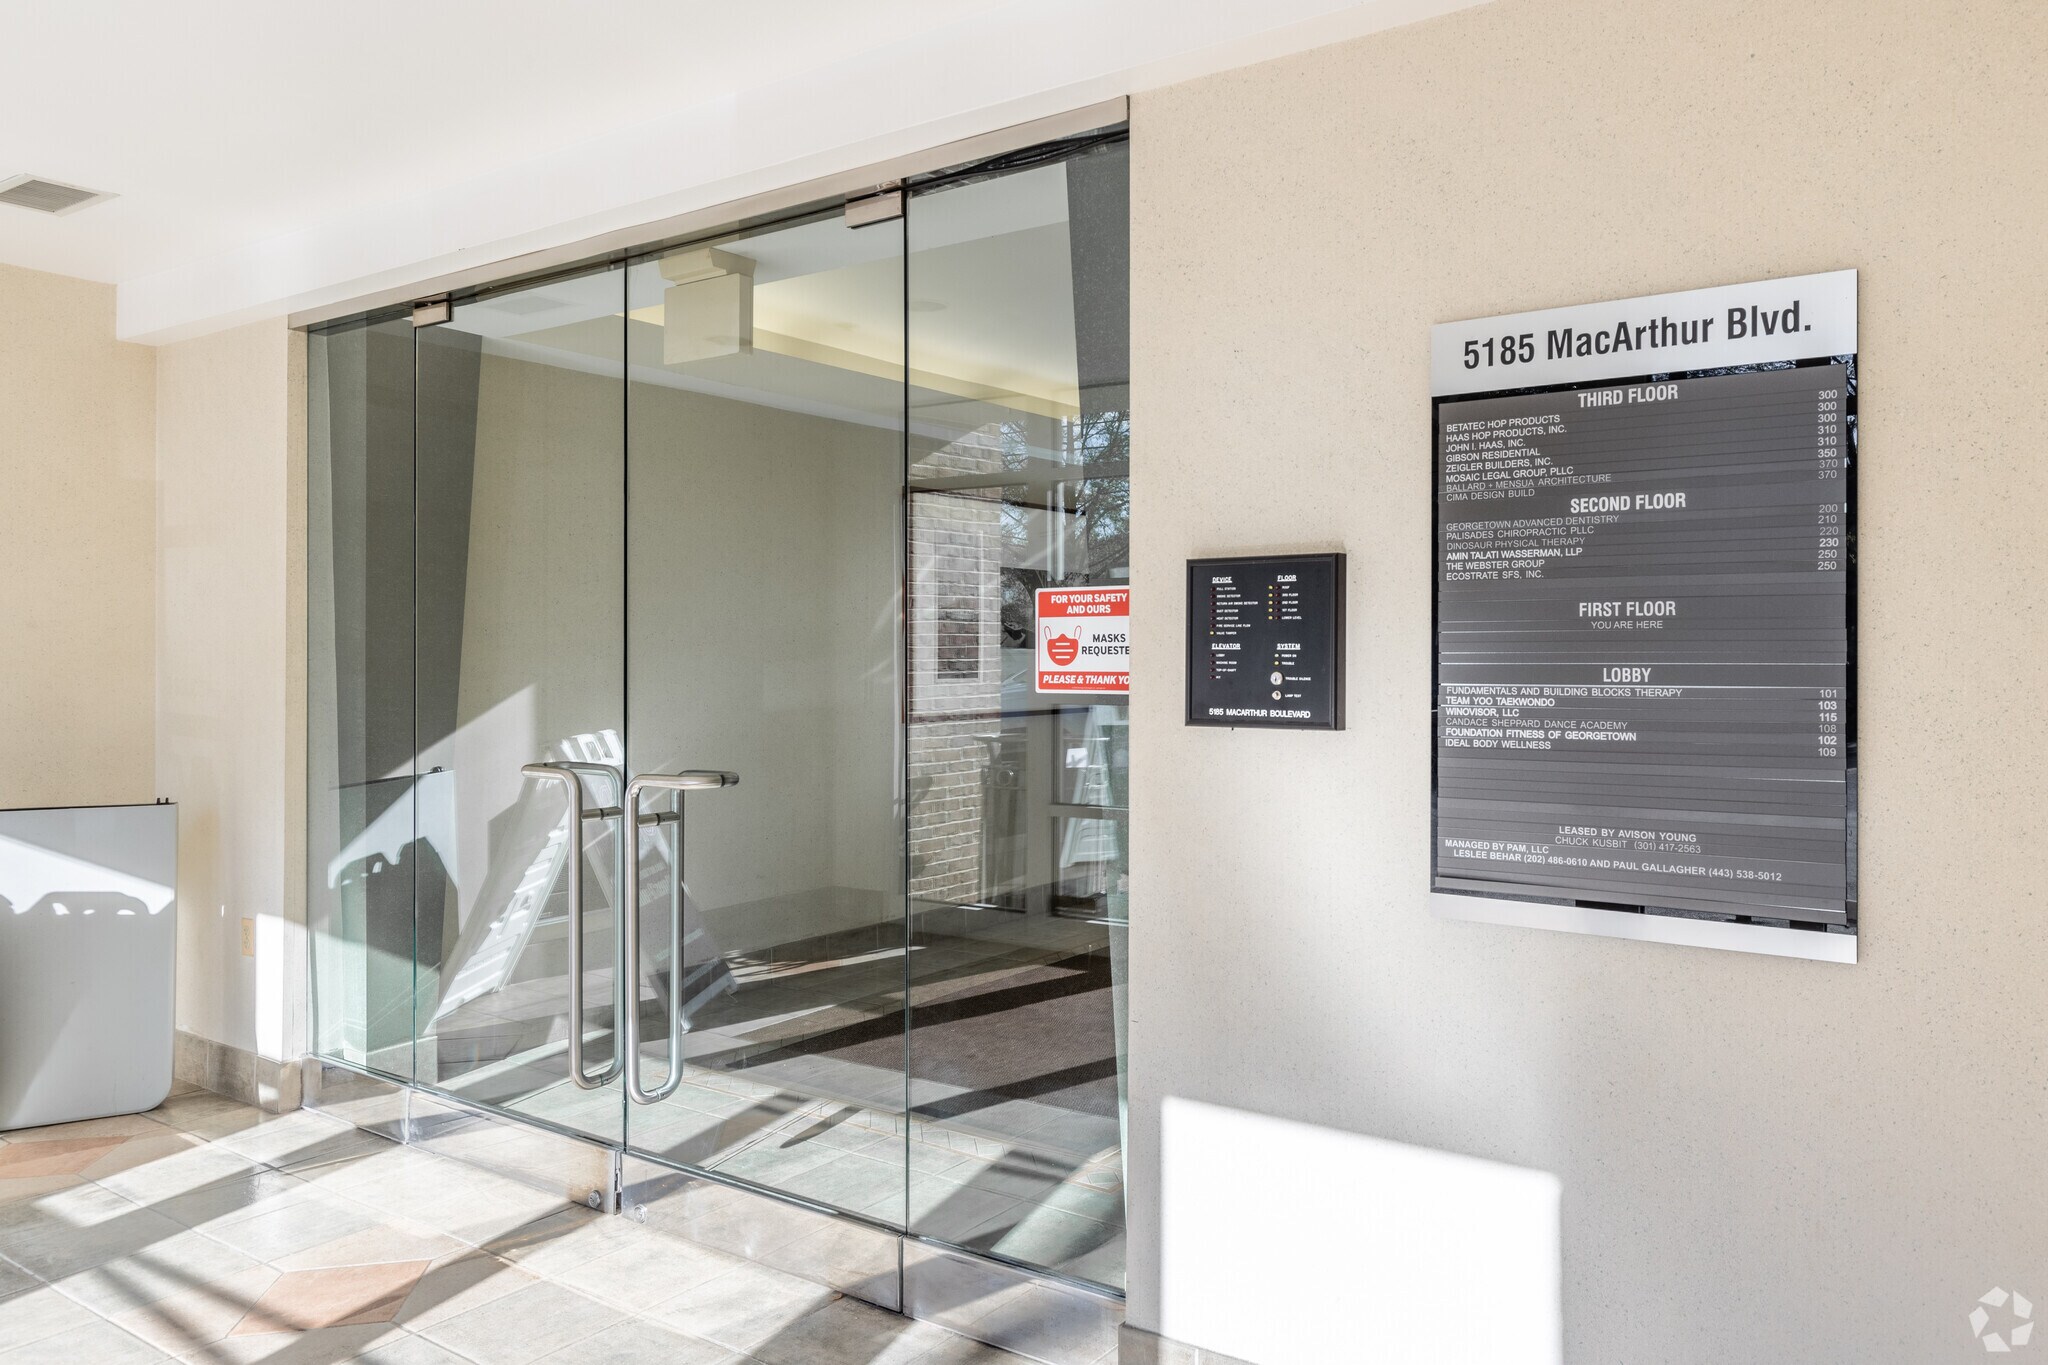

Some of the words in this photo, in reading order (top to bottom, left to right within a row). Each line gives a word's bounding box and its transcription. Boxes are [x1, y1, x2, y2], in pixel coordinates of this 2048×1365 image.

[1463, 333, 1534, 369] 5185
[1547, 316, 1713, 360] MacArthur
[1727, 300, 1812, 340] Blvd.
[1577, 389, 1622, 408] THIRD
[1628, 384, 1678, 404] FLOOR
[1819, 390, 1837, 399] 300
[1818, 402, 1836, 411] 300
[1818, 413, 1836, 422] 300
[1446, 422, 1485, 432] BETATEC
[1487, 420, 1506, 429] HOP
[1508, 415, 1560, 427] PRODUCTS
[1445, 433, 1469, 442] HAAS
[1471, 431, 1491, 440] HOP
[1492, 426, 1545, 438] PRODUCTS,
[1548, 425, 1566, 434] INC.
[1818, 425, 1836, 434] 310
[1445, 443, 1469, 452] JOHN
[1478, 440, 1505, 450] HAAS,
[1507, 439, 1525, 448] INC.
[1818, 436, 1836, 445] 310
[1445, 453, 1479, 462] GIBSON
[1481, 448, 1540, 460] RESIDENTIAL
[1818, 448, 1836, 458] 350
[1445, 462, 1482, 473] ZEIGLER
[1484, 458, 1532, 470] BUILDERS,
[1534, 457, 1552, 466] INC.
[1819, 459, 1838, 468] 370
[1445, 473, 1480, 483] MOSAIC
[1482, 471, 1511, 480] LEGAL
[1512, 468, 1547, 478] GROUP,
[1550, 467, 1573, 476] PLLC
[1818, 470, 1837, 479] 370
[1446, 482, 1485, 492] BALLARD
[1495, 479, 1534, 489] MENSUA
[1537, 474, 1611, 486] ARCHITECTURE
[1446, 493, 1468, 502] CIMA
[1470, 491, 1504, 500] DESIGN
[1508, 489, 1534, 498] BUILD
[1570, 496, 1630, 514] SECOND
[1635, 493, 1685, 510] FLOOR
[1819, 504, 1838, 513] 200
[1445, 520, 1510, 531] GEORGETOWN
[1512, 518, 1563, 528] ADVANCED
[1565, 515, 1618, 526] DENTISTRY
[1818, 515, 1837, 524] 210
[1446, 530, 1493, 540] PALISADES
[1497, 527, 1566, 538] CHIROPRACTIC
[1570, 526, 1594, 535] PLLC
[1820, 527, 1838, 535] 220
[1446, 541, 1492, 550] DINOSAUR
[1494, 539, 1539, 548] PHYSICAL
[1542, 537, 1584, 547] THERAPY
[1820, 538, 1839, 547] 230
[1446, 552, 1468, 560] AMIN
[1470, 551, 1498, 560] TALATI
[1500, 548, 1562, 559] WASSERMAN,
[1565, 548, 1582, 557] LLP
[1818, 550, 1837, 558] 250
[1445, 562, 1463, 570] THE
[1465, 561, 1509, 570] WEBSTER
[1511, 560, 1544, 569] GROUP
[1818, 561, 1836, 570] 250
[1446, 571, 1498, 581] ECOSTRATE
[1502, 571, 1521, 579] SFS,
[1525, 570, 1543, 579] INC.
[1050, 595, 1068, 604] FOR
[1069, 594, 1092, 603] YOUR
[1094, 593, 1126, 602] SAFETY
[1066, 605, 1085, 614] AND
[1086, 605, 1110, 613] OURS
[1579, 602, 1621, 617] FIRST
[1626, 601, 1675, 616] FLOOR
[1613, 621, 1633, 629] ARE
[1636, 621, 1663, 629] HERE
[1092, 634, 1125, 642] MASKS
[1081, 646, 1129, 656] REQUESTE
[1042, 675, 1076, 684] PLEASE
[1085, 675, 1116, 684] THANK
[1118, 676, 1129, 684] YO
[1603, 668, 1650, 682] LOBBY
[1446, 687, 1517, 695] FUNDAMENTALS
[1519, 687, 1540, 696] AND
[1543, 687, 1587, 696] BUILDING
[1591, 688, 1631, 696] BLOCKS
[1634, 688, 1682, 697] THERAPY
[1820, 690, 1836, 698] 101
[1446, 697, 1470, 705] TEAM
[1473, 697, 1493, 705] YOO
[1496, 698, 1555, 707] TAEKWONDO
[1818, 701, 1837, 710] 103
[1226, 708, 1267, 717] MACARTHUR
[1269, 709, 1310, 718] BOULEVARD
[1445, 707, 1498, 717] WINOVISOR,
[1502, 708, 1519, 717] LLC
[1819, 713, 1837, 721] 115
[1445, 718, 1487, 727] CANDACE
[1491, 719, 1540, 728] SHEPPARD
[1544, 720, 1576, 729] DANCE
[1579, 721, 1627, 730] ACADEMY
[1819, 725, 1836, 733] 108
[1445, 728, 1502, 737] FOUNDATION
[1506, 730, 1544, 738] FITNESS
[1547, 730, 1561, 739] OF
[1564, 731, 1636, 741] GEORGETOWN
[1444, 739, 1470, 747] IDEAL
[1472, 740, 1498, 748] BODY
[1500, 740, 1551, 749] WELLNESS
[1818, 736, 1837, 744] 102
[1818, 748, 1836, 756] 109
[1558, 826, 1597, 836] LEASED
[1601, 828, 1614, 838] BY
[1617, 830, 1654, 840] AVISON
[1659, 832, 1696, 842] YOUNG
[1444, 839, 1490, 850] MANAGED
[1492, 842, 1504, 851] BY
[1506, 843, 1528, 852] PAM,
[1531, 845, 1548, 854] LLC
[1554, 836, 1588, 847] CHUCK
[1592, 838, 1626, 849] KUSBIT
[1634, 841, 1656, 851] (301)
[1658, 842, 1700, 854] 417-2563
[1453, 849, 1487, 859] LESLEE
[1489, 852, 1521, 862] BEHAR
[1523, 854, 1545, 864] (202)
[1547, 856, 1587, 867] 486-0610
[1589, 859, 1610, 868] AND
[1613, 861, 1638, 870] PAUL
[1641, 863, 1705, 876] GALLAGHER
[1708, 867, 1733, 878] (443)
[1736, 869, 1781, 881] 538-5012
